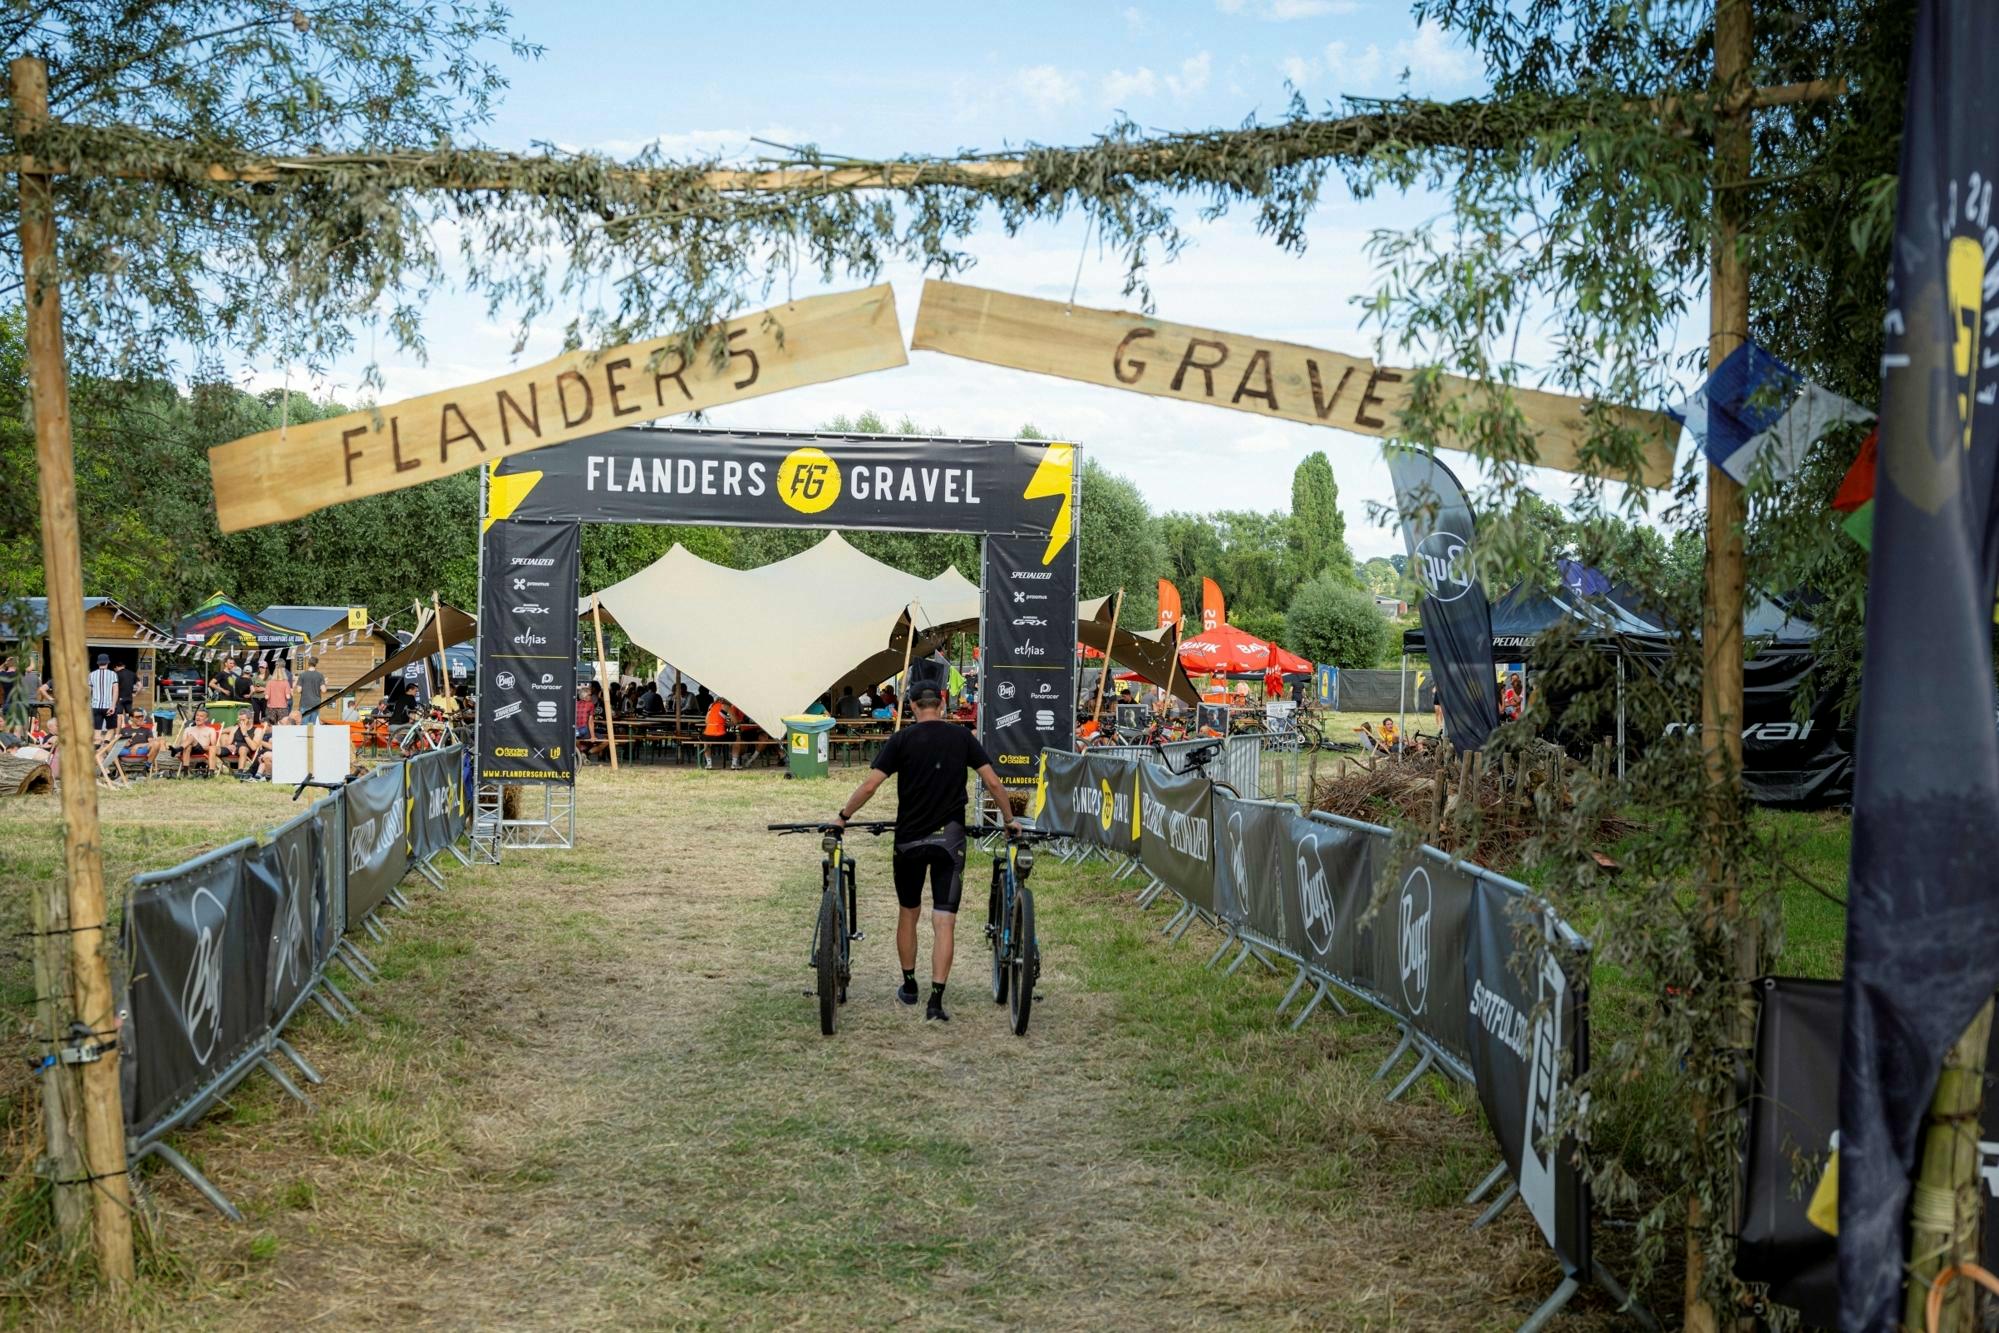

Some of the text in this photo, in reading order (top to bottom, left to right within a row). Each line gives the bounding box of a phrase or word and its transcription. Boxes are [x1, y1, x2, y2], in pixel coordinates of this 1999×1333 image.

[1113, 327, 1401, 429] GRAVE
[586, 454, 766, 496] FLANDERS
[850, 465, 981, 504] GRAVEL
[510, 557, 555, 566] SPECIALIZED
[1010, 571, 1052, 580] SPECIALIZED
[512, 606, 550, 614] GRX
[514, 626, 547, 647] ethias
[1014, 638, 1045, 658] ethias
[1178, 641, 1221, 653] BAVIK
[1030, 692, 1060, 700] Panaracer
[482, 769, 570, 779] WWW.FLANDERSGRAVEL.CC
